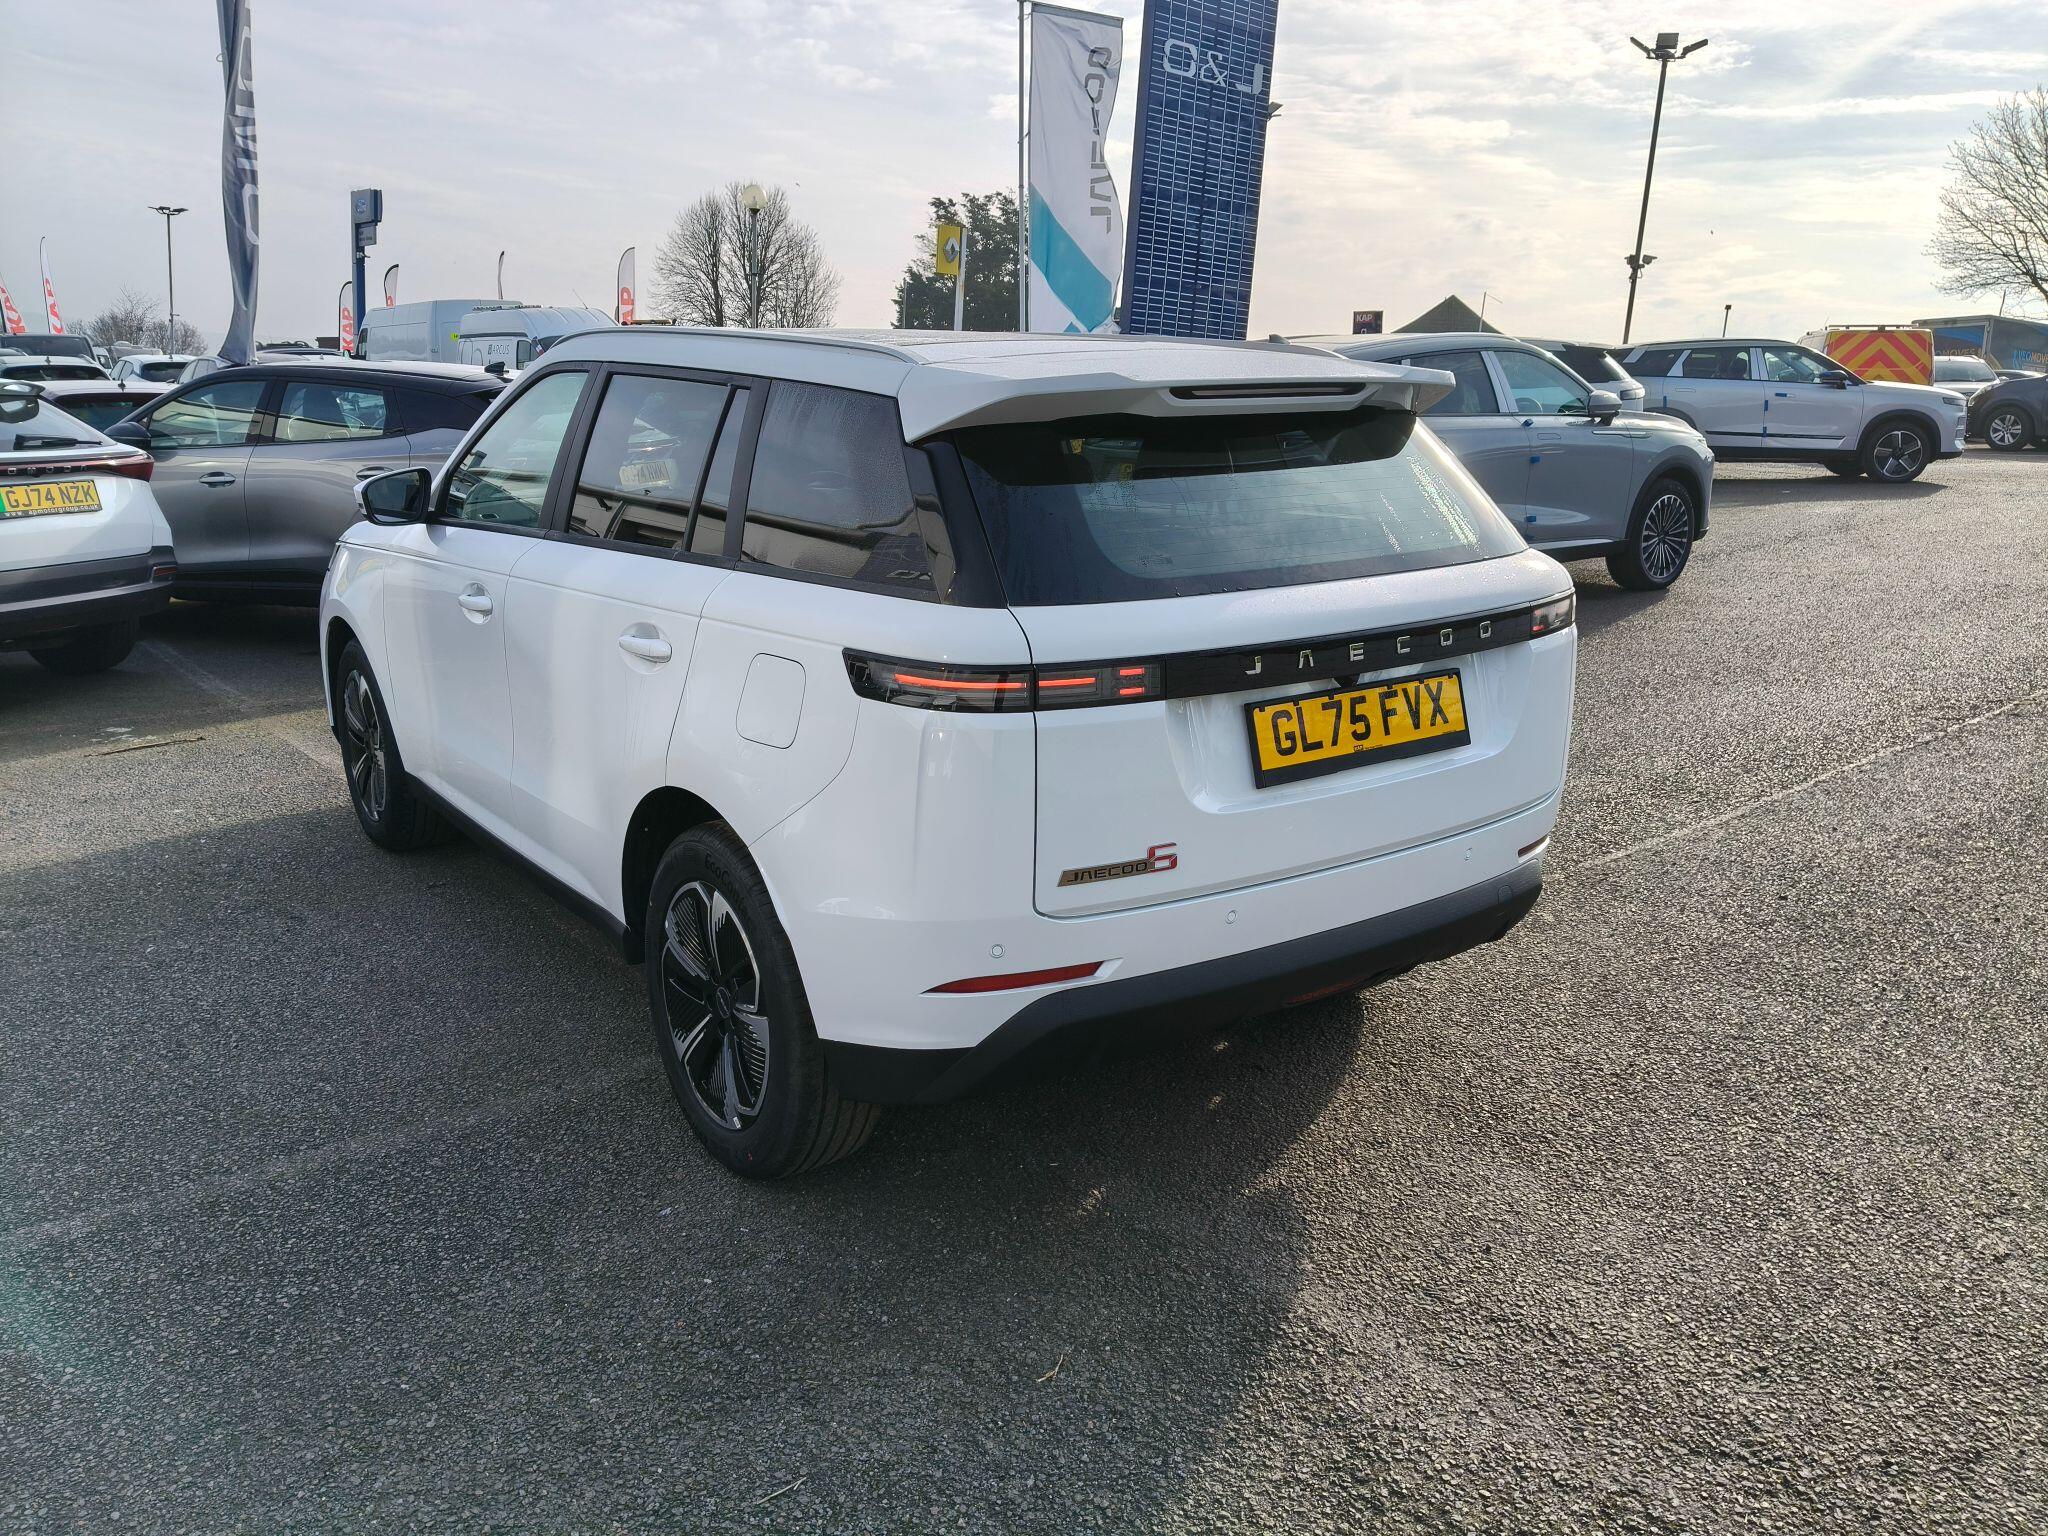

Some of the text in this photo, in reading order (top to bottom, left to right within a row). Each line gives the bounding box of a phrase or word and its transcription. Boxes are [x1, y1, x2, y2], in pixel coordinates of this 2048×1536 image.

[341, 306, 355, 351] KAP
[1356, 313, 1373, 322] KAP
[5, 484, 95, 508] GJ74 NZK
[1244, 620, 1492, 676] JAECOO
[1270, 680, 1449, 757] GL75 FVX
[1066, 861, 1148, 883] JAECOO
